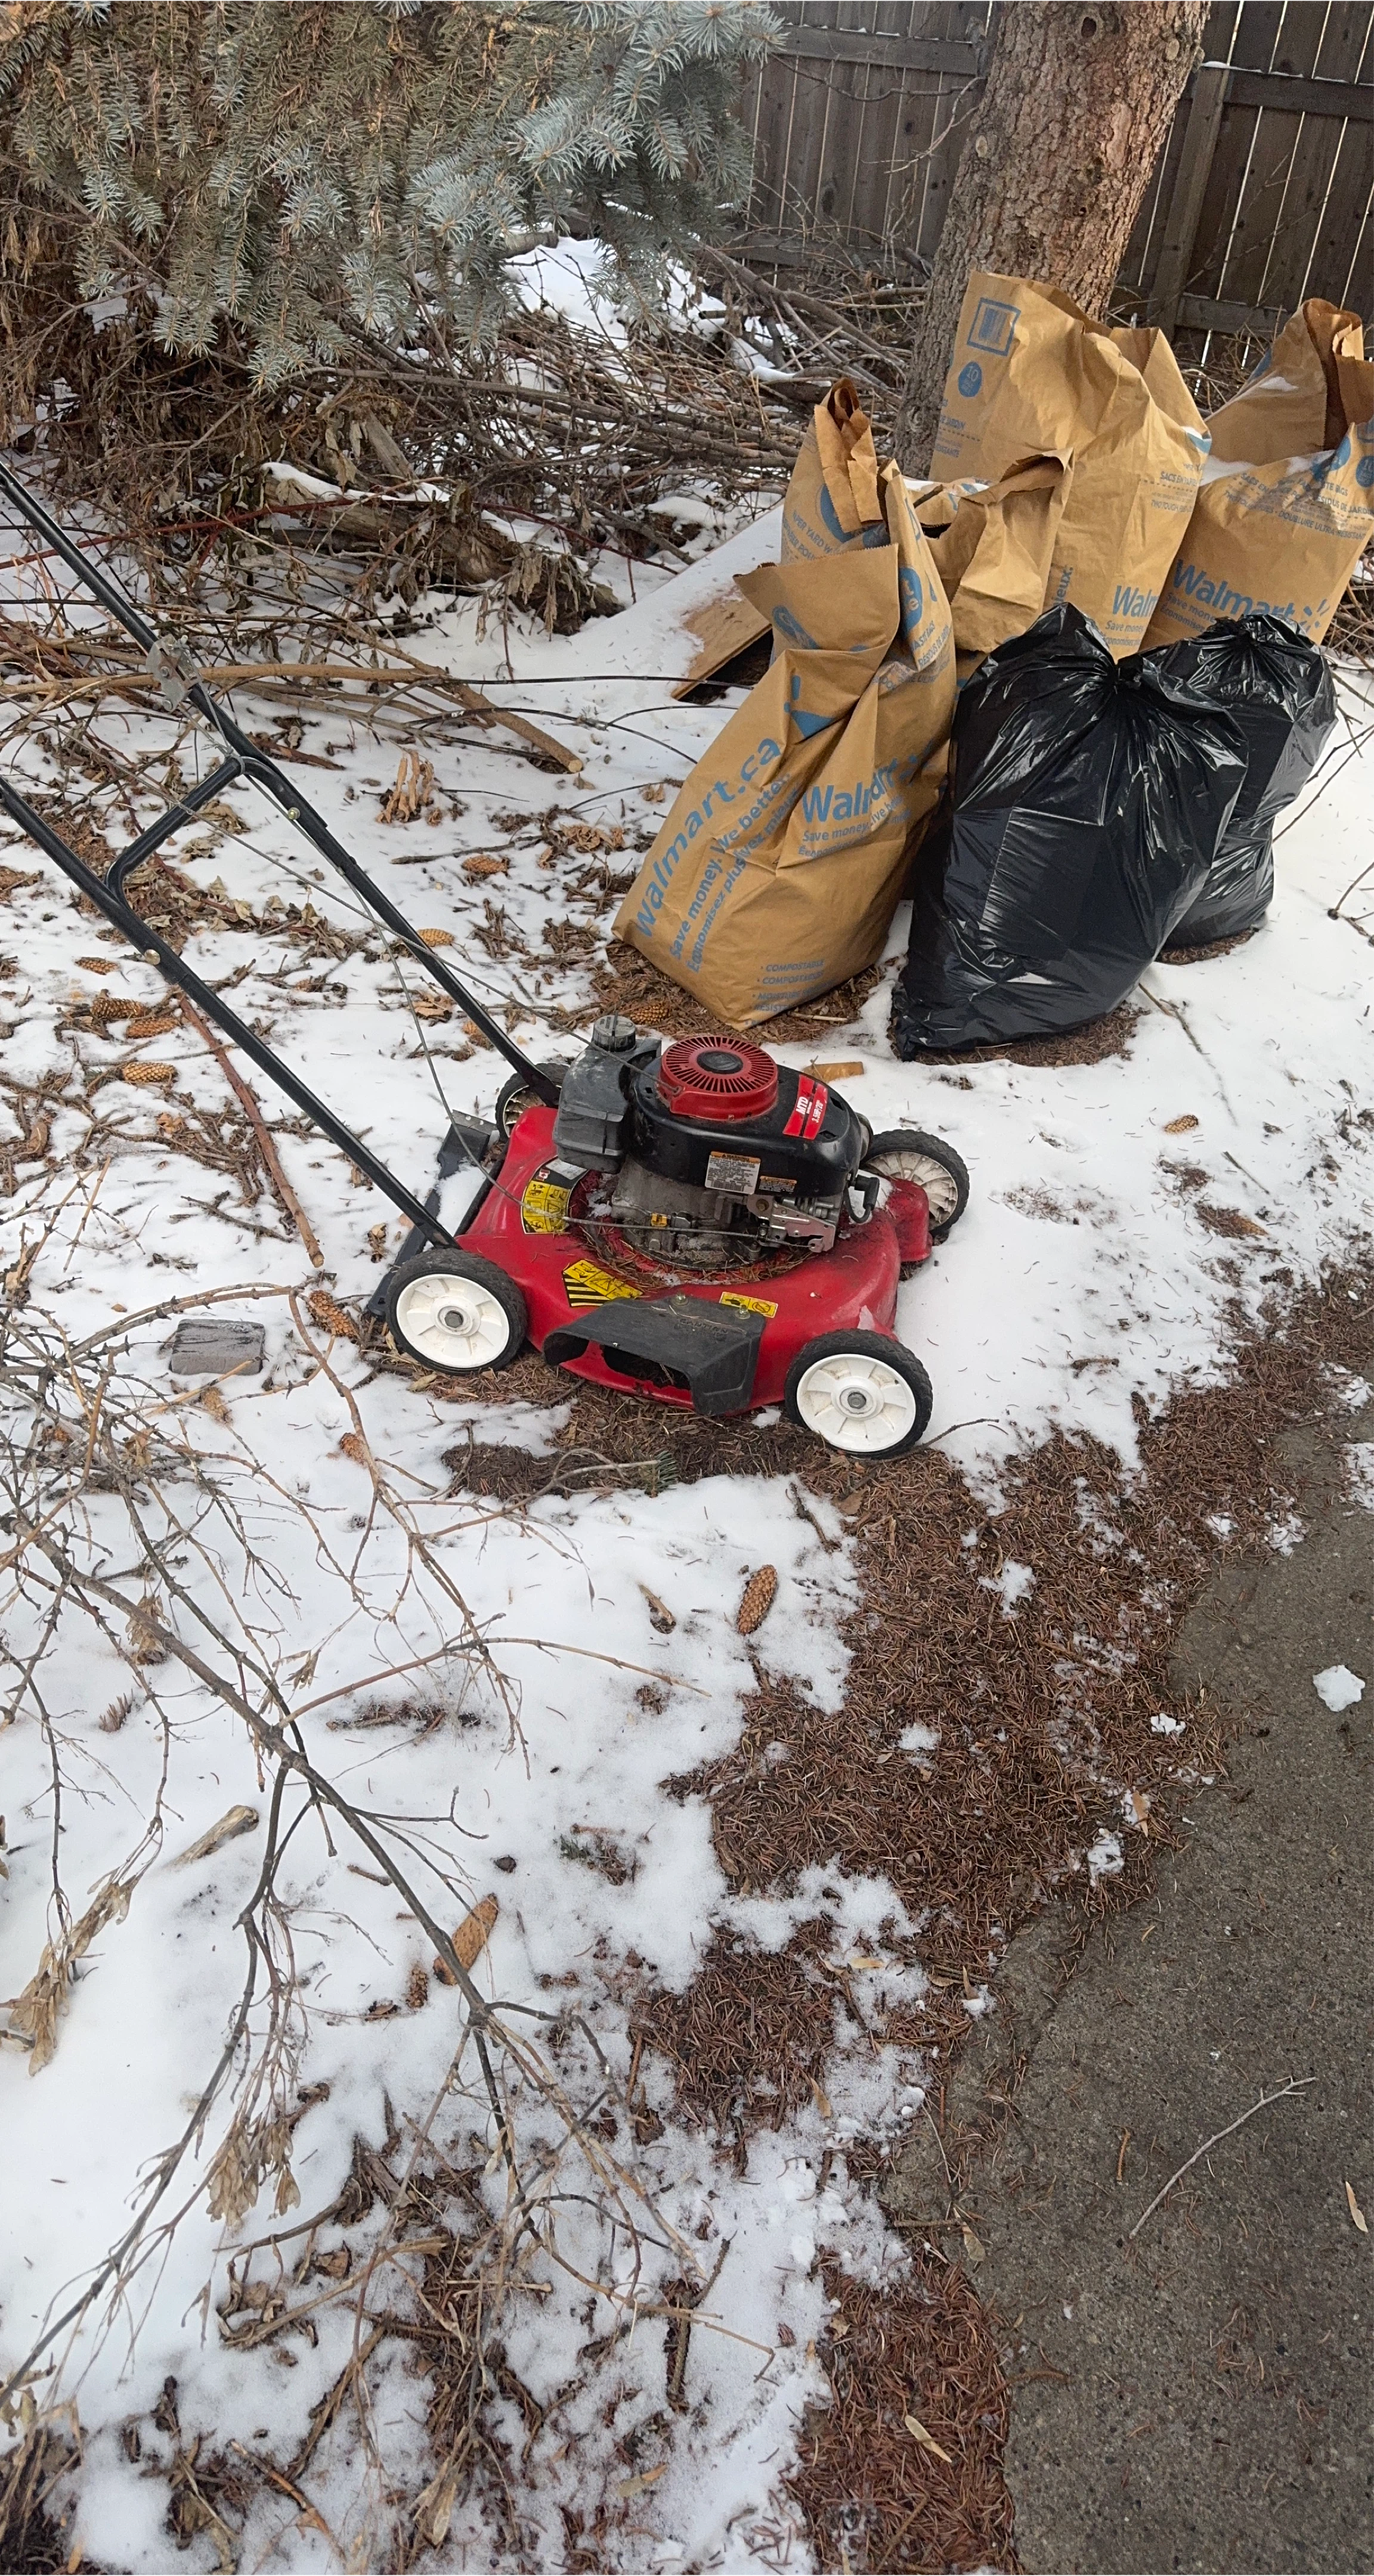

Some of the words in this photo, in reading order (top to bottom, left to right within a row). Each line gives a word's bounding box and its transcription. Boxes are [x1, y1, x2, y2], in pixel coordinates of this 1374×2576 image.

[1173, 559, 1295, 617] Walmart
[803, 829, 830, 843] Save
[669, 920, 691, 961] Save
[688, 858, 723, 920] money.
[796, 1097, 809, 1115] MTD
